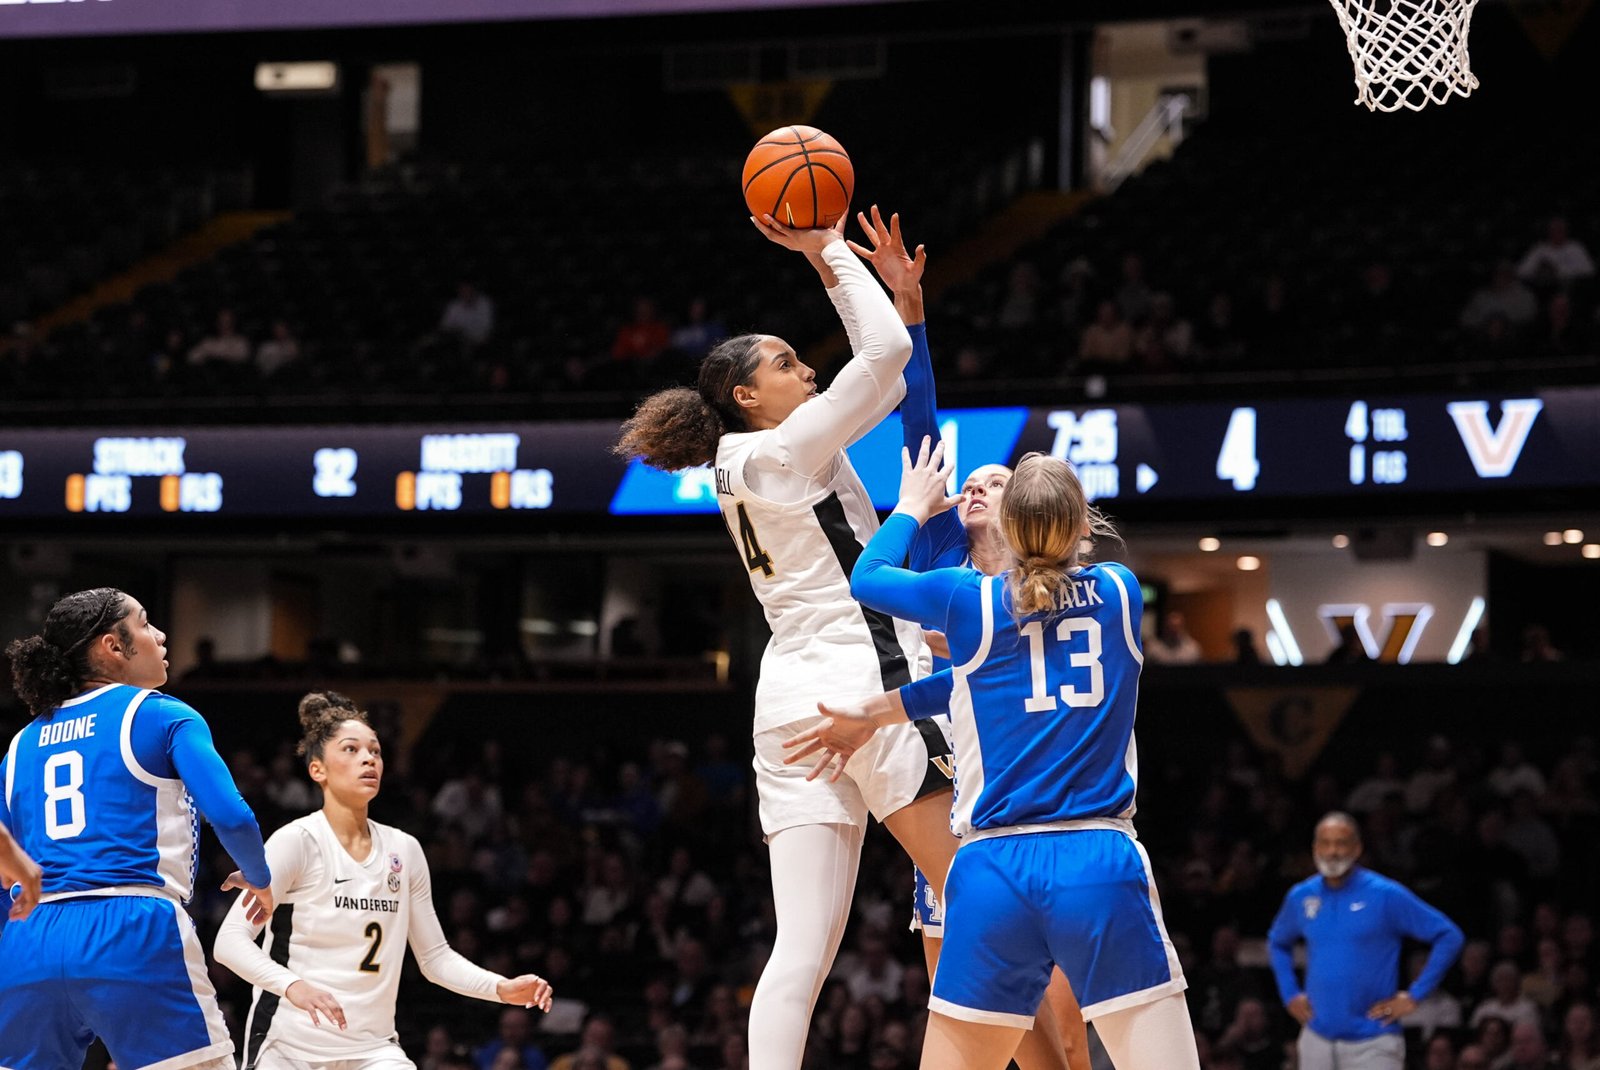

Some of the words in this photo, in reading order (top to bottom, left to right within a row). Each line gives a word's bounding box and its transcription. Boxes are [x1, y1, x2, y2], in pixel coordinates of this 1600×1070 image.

[1216, 407, 1260, 491] 4
[1020, 616, 1105, 713] 13
[38, 713, 97, 747] BOONE
[44, 749, 87, 841] 8
[358, 921, 384, 974] 2
